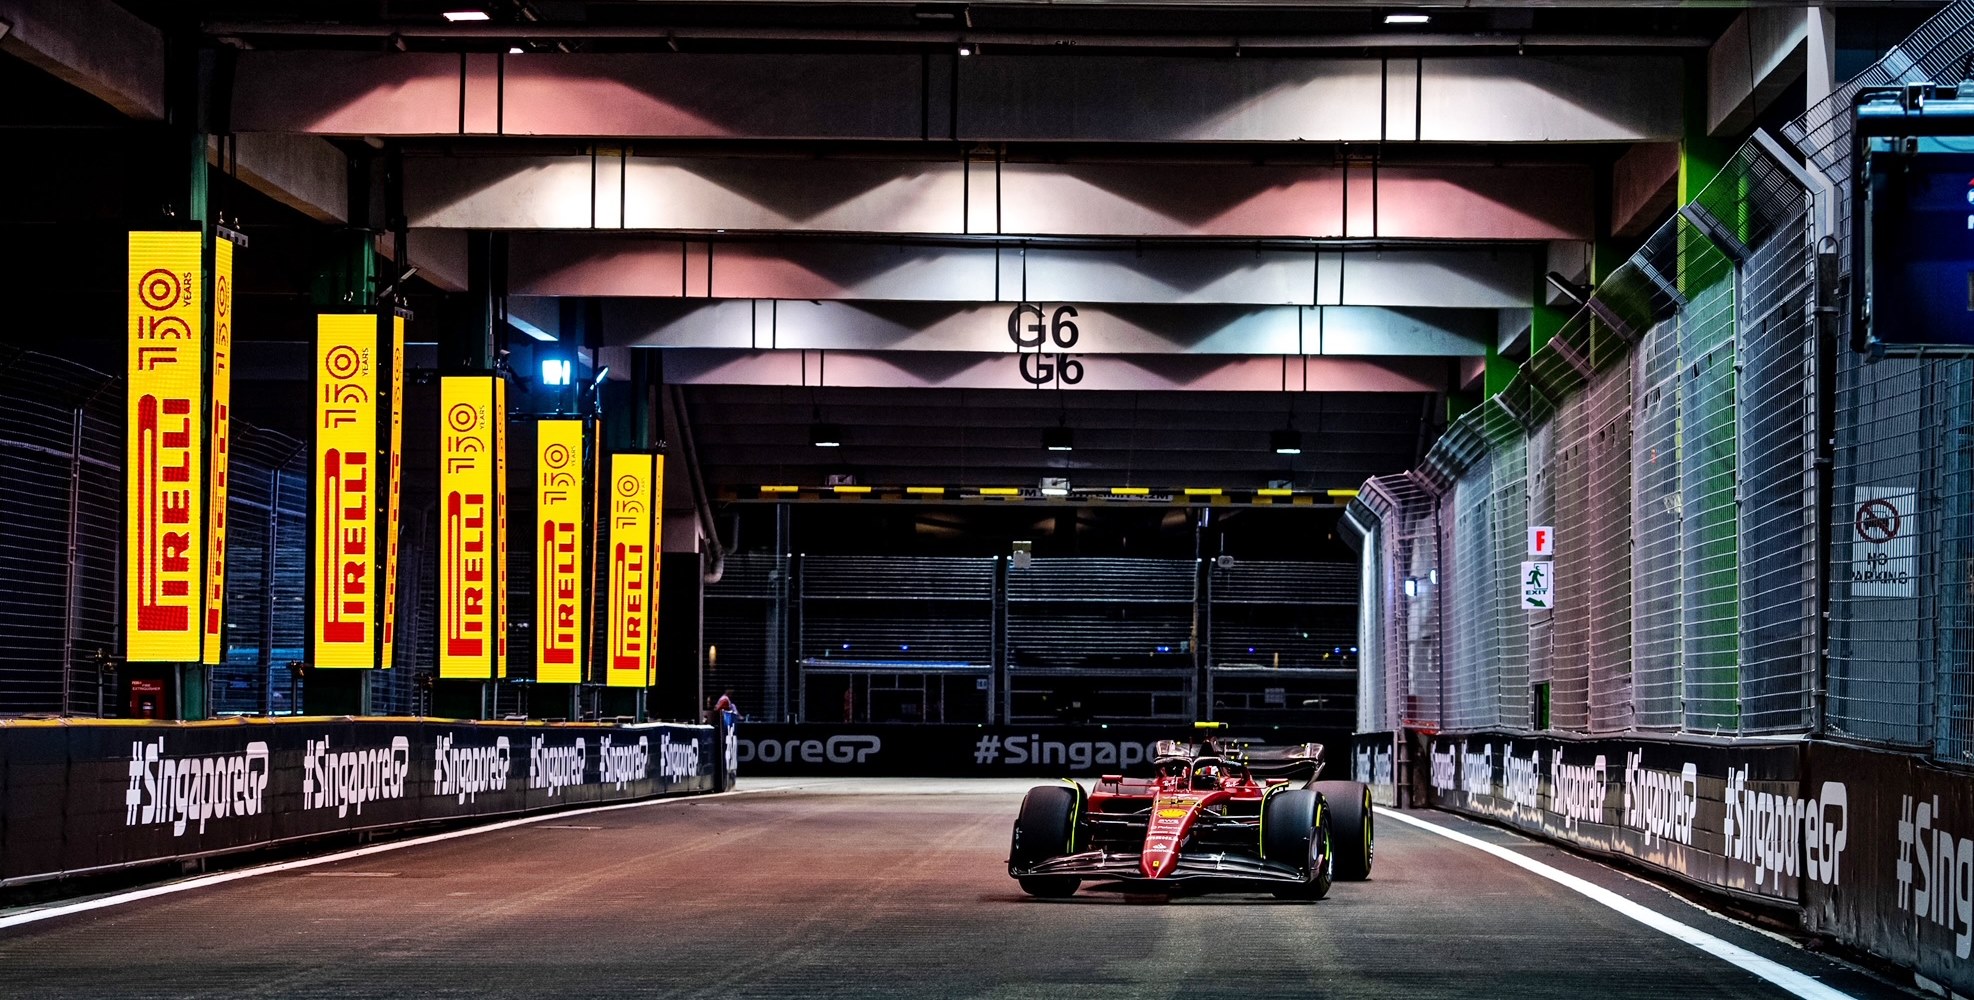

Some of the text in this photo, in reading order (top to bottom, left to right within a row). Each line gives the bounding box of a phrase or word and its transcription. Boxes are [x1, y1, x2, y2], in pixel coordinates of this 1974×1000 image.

[138, 269, 192, 371] 150
[183, 272, 192, 308] YEARS
[1008, 304, 1079, 349] G6
[325, 345, 368, 428] 150
[1019, 353, 1084, 385] G6
[448, 403, 485, 474] 150
[544, 444, 576, 505] 150
[137, 394, 190, 631] PIRELLI
[616, 475, 645, 529] 150
[1536, 530, 1545, 551] F
[323, 448, 367, 643] PIRELLI
[447, 490, 484, 657] PIRELLI
[1867, 552, 1888, 566] NO
[543, 519, 575, 664] PIRELLI
[613, 542, 643, 670] PIRELLI
[126, 736, 269, 837] #SingaporeGP
[303, 734, 409, 819] #SingaporeGP
[434, 732, 510, 805] #SingaporeGP
[529, 733, 586, 797] #SingaporeGP
[600, 733, 648, 791] #SingaporeGP
[1551, 746, 1606, 832] #SingaporeGP
[1624, 747, 1697, 849] #SingaporeGP
[1724, 763, 1848, 891] #SingaporeGP
[1897, 794, 1974, 960] #Sing
